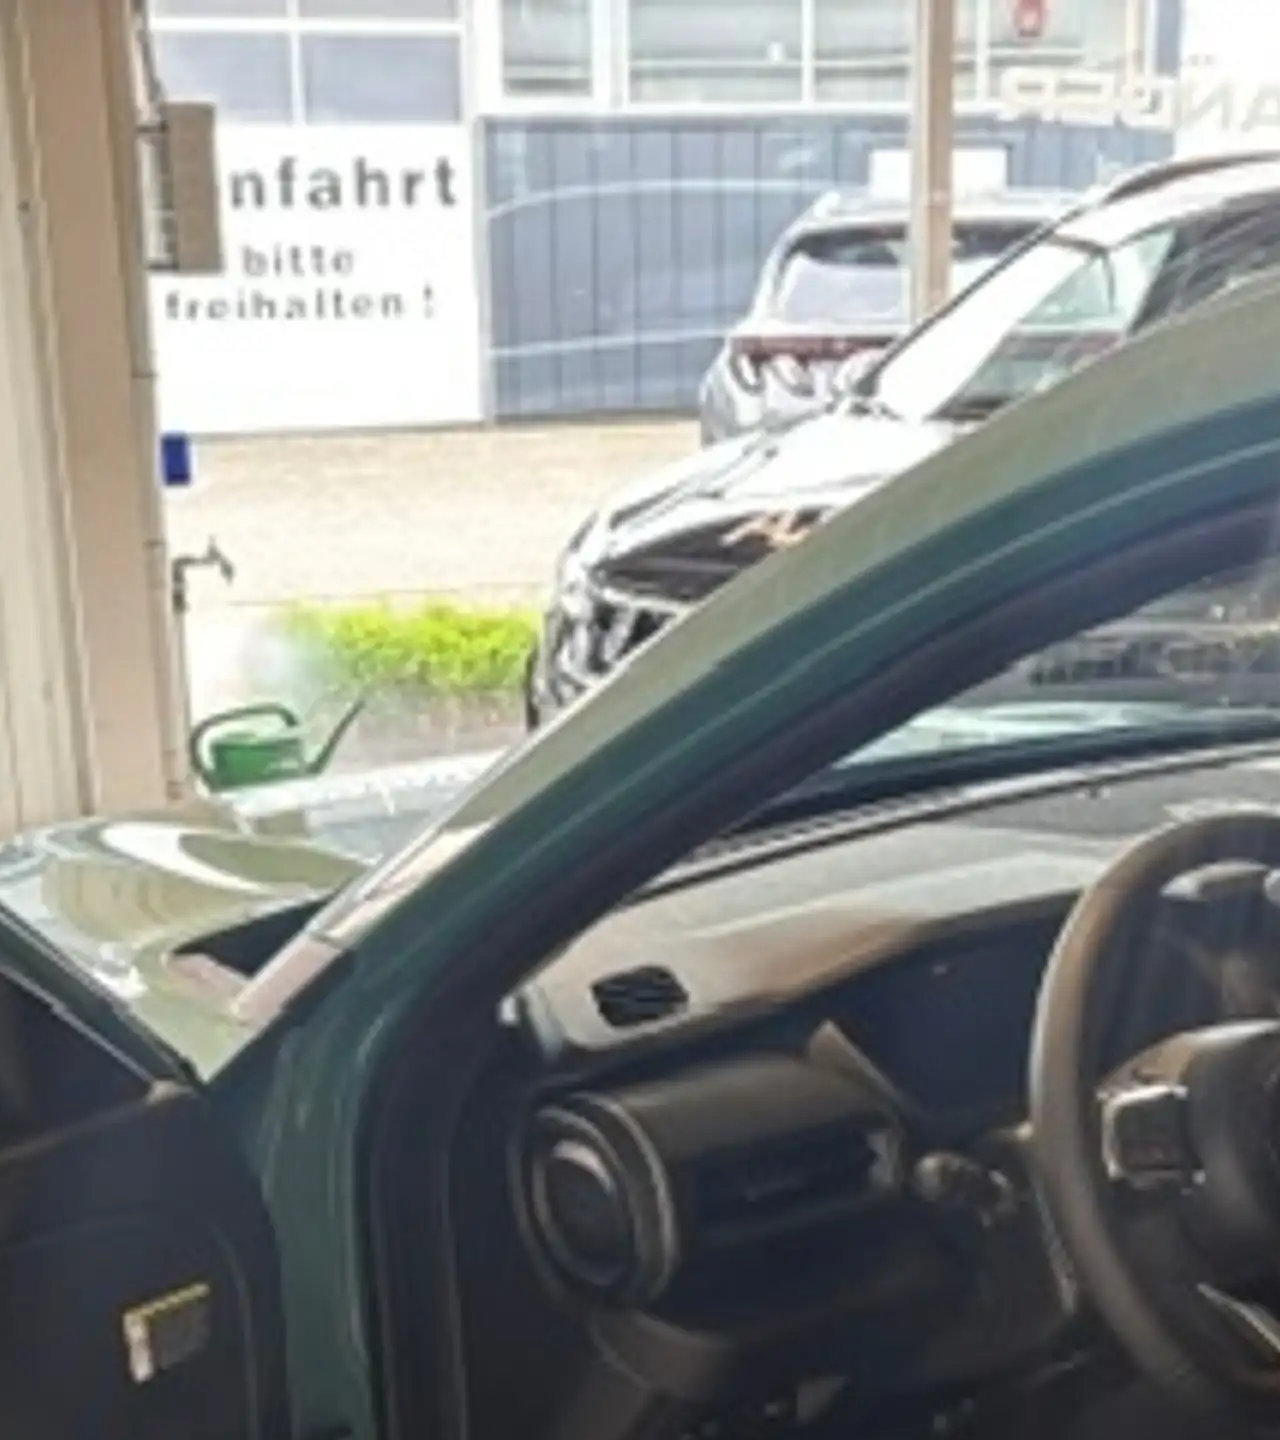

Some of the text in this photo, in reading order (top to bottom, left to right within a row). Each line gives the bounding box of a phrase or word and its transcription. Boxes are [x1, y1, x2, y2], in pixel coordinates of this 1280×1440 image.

[228, 155, 458, 211] nfahrt
[242, 242, 356, 278] bitte
[165, 286, 406, 321] freihalten
